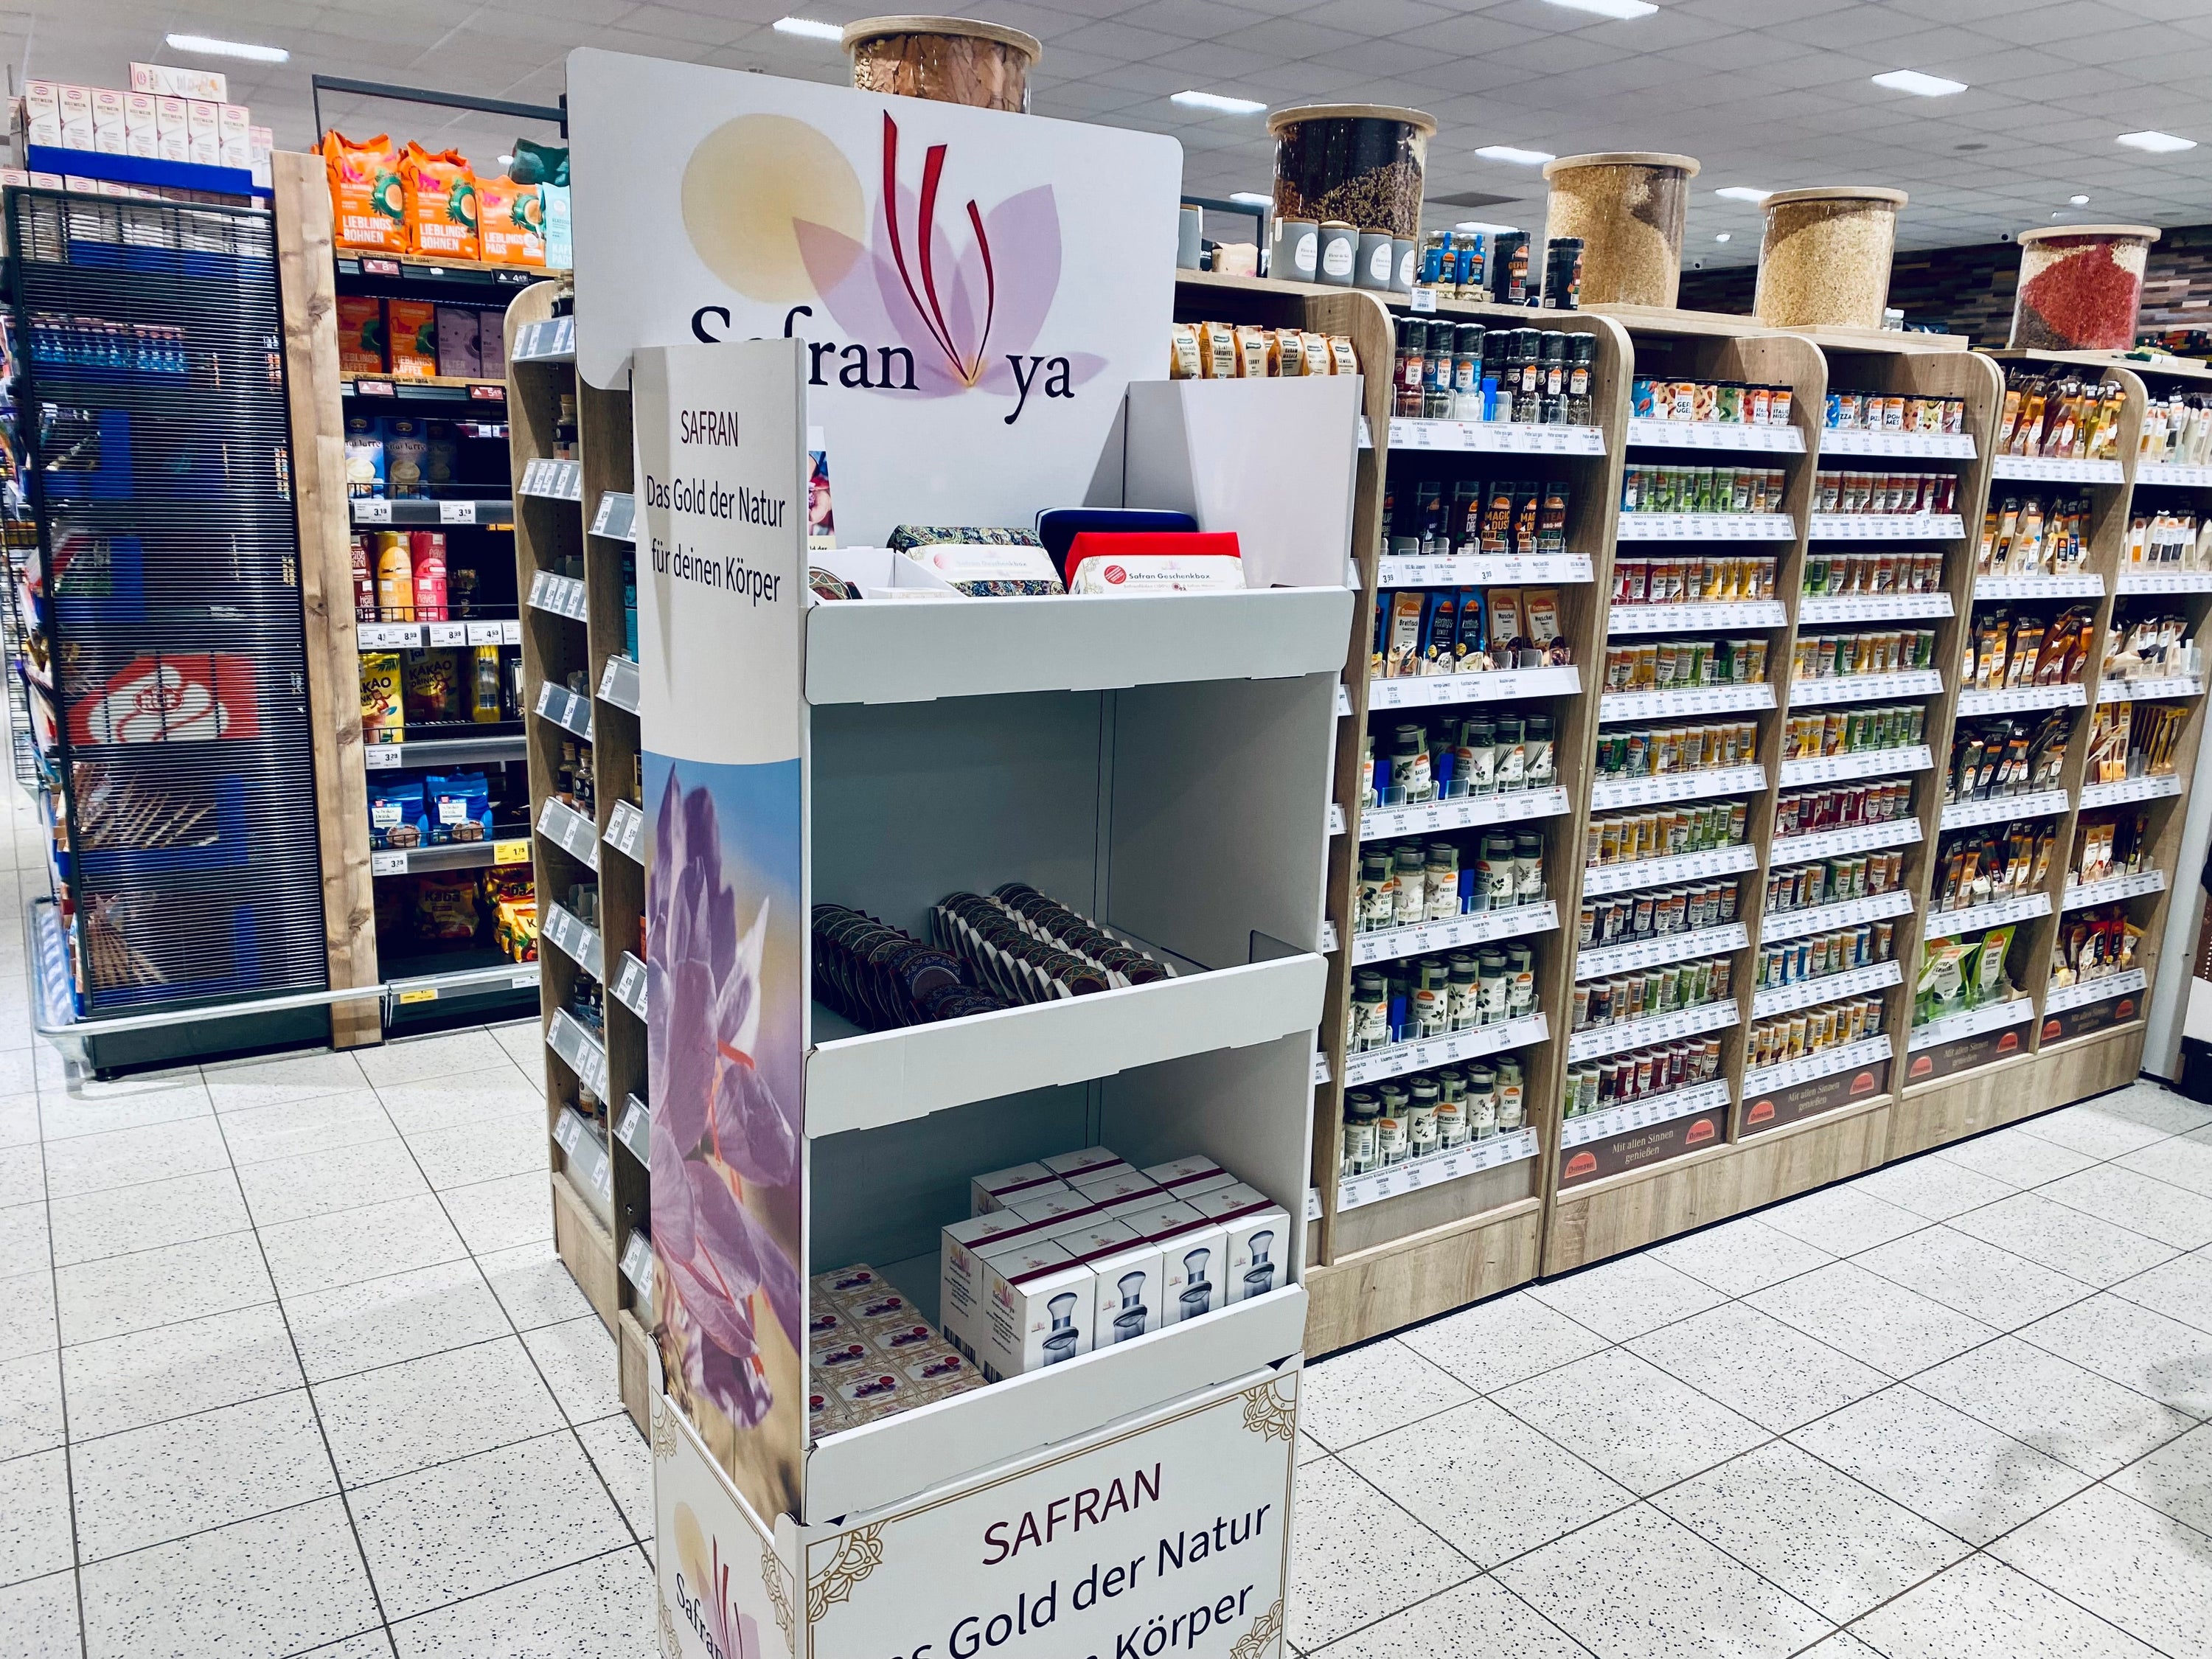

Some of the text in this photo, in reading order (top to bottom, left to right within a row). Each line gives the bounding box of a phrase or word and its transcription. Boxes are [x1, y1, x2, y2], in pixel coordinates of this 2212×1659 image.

[342, 215, 392, 231] LIEBLINGS
[420, 223, 467, 238] LIEBLINGS
[343, 229, 385, 244] BOHNEN
[420, 236, 459, 251] BOHNEN
[484, 232, 524, 245] LIEBLINGS
[484, 243, 507, 255] PADS
[393, 354, 432, 366] LIEBLINGS
[393, 364, 422, 376] KAFFEE
[681, 410, 739, 447] SAFRAN
[647, 475, 785, 528] Das Gold der Natur
[1484, 510, 1510, 521] MAGIC
[652, 538, 781, 607] für deinen Körper
[1157, 571, 1211, 580] Geschenkbox
[409, 660, 452, 680] KAKAO
[411, 676, 434, 687] DRINK
[425, 888, 460, 903] Kaba
[1787, 1081, 1840, 1102] Mit allen Sinnen
[1798, 1096, 1827, 1113] genießen
[1612, 1129, 1674, 1154] Mit allen Sinnen
[1624, 1146, 1660, 1165] genießen
[981, 1462, 1161, 1565] SAFRAN
[949, 1503, 1271, 1656] Gold der Natur
[675, 1572, 726, 1659] Safran
[1116, 1584, 1254, 1659] Körper
